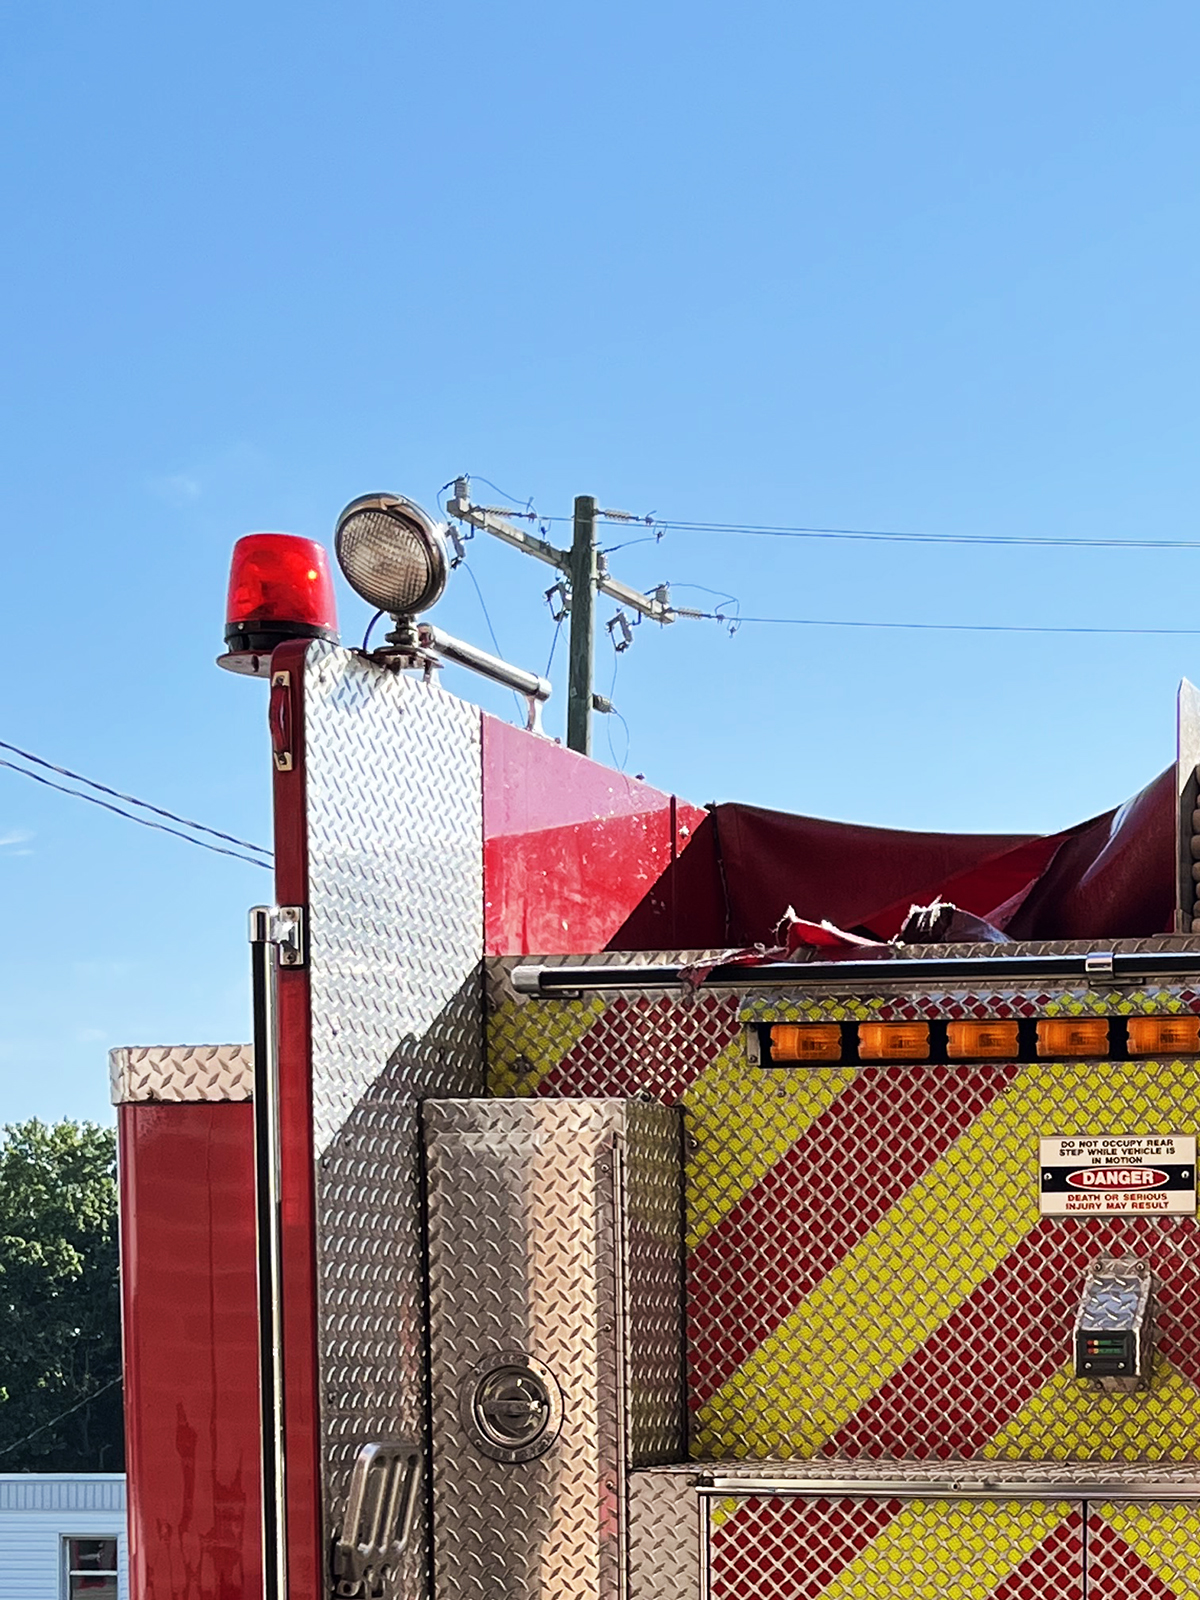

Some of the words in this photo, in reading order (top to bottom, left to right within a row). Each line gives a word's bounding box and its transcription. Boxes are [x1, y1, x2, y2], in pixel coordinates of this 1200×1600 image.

[1061, 1140, 1075, 1148] DO
[1079, 1140, 1099, 1148] NOT
[1102, 1139, 1143, 1147] OCCUPY
[1146, 1139, 1174, 1147] REAR
[1059, 1148, 1084, 1156] STEP
[1087, 1148, 1117, 1156] WHILE
[1121, 1147, 1162, 1155] VEHICLE
[1166, 1147, 1176, 1155] IS
[1105, 1156, 1143, 1164] MOTION
[1082, 1170, 1154, 1185] DANGER
[1104, 1193, 1119, 1201] OR
[1123, 1193, 1168, 1201] SERIOUS
[1066, 1202, 1102, 1210] INJURY
[1106, 1202, 1127, 1210] MAY
[1131, 1201, 1169, 1209] RESULT
